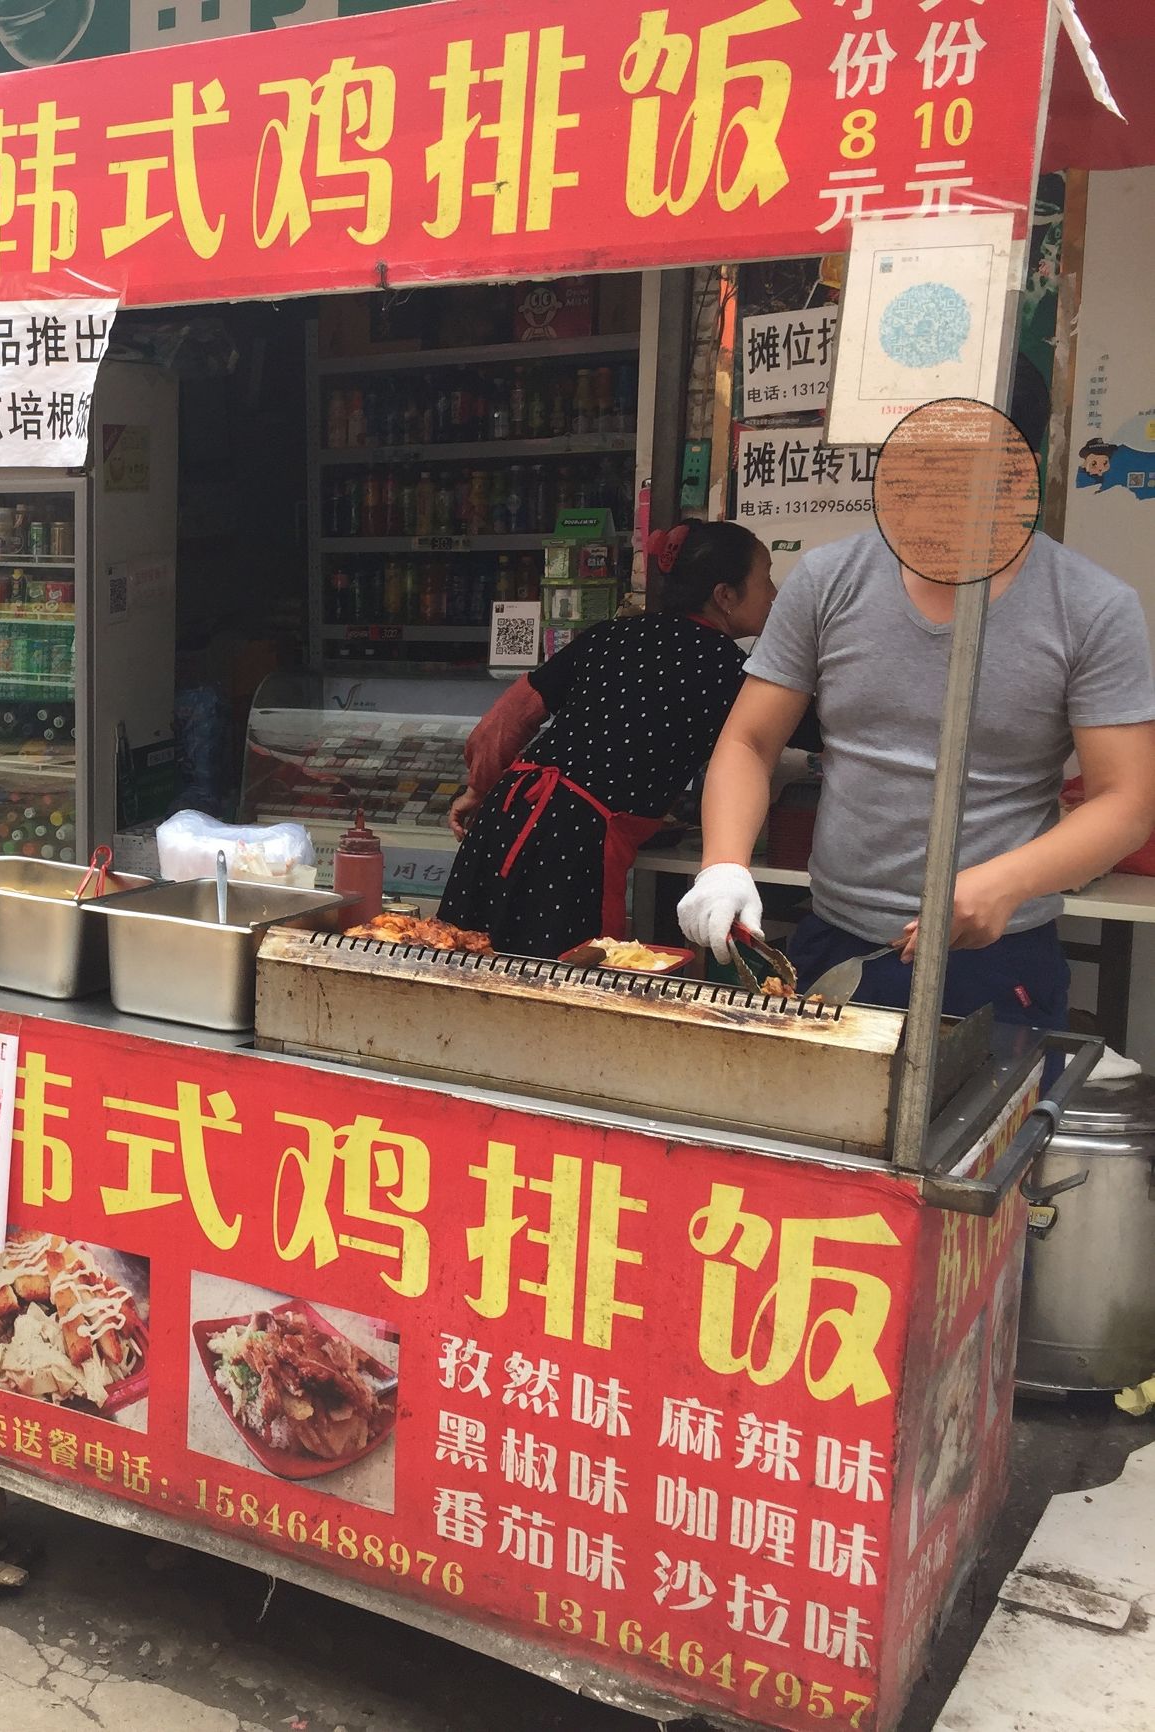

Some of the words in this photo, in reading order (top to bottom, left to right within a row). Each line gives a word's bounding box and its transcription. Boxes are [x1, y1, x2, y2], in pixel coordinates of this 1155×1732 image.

[743, 439, 880, 488] 摊位转让
[435, 1409, 629, 1515] 黑椒味
[655, 1474, 881, 1587] 咖喱味
[439, 1332, 632, 1438] 孜然味
[657, 1396, 887, 1503] 麻辣味
[432, 1487, 626, 1591] 番茄味
[653, 1550, 874, 1669] 沙拉味
[533, 1590, 873, 1730] 13164647957
